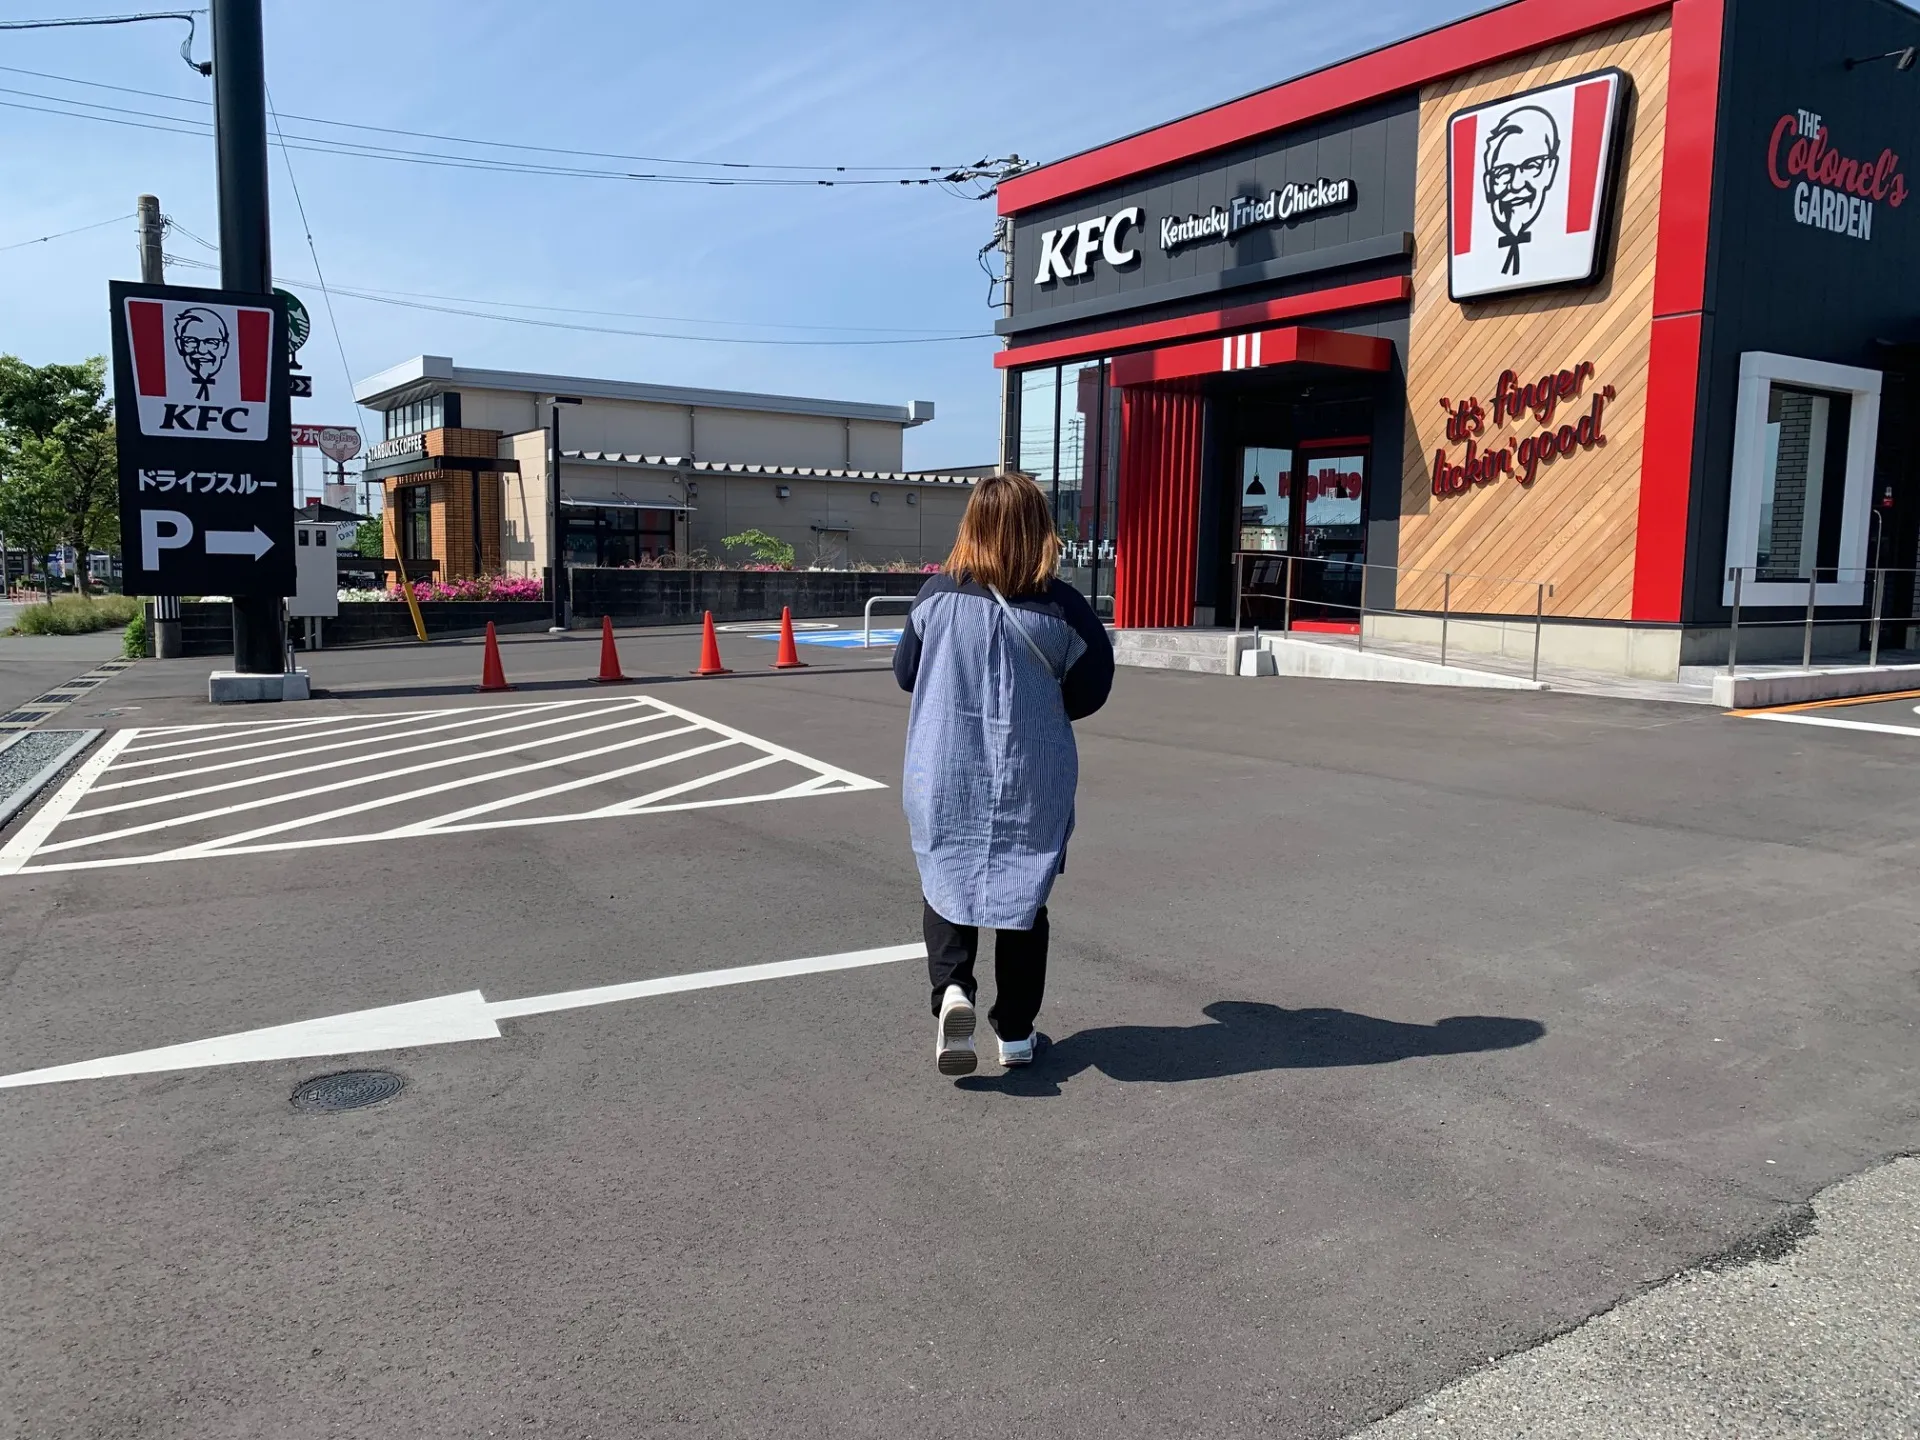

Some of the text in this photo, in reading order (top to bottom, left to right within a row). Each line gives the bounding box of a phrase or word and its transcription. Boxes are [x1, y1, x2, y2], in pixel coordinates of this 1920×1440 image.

[1797, 108, 1822, 140] THE
[1768, 114, 1909, 207] Colonel's
[1160, 178, 1349, 249] Kentucky Fried Chicken
[1794, 181, 1873, 241] GARDEN
[1034, 206, 1139, 284] KFC
[159, 404, 249, 433] KFC
[1489, 361, 1594, 424] finger
[368, 434, 422, 463] STARBUCKS COFFEE
[138, 468, 278, 495] ドライブスルー
[140, 509, 194, 571] P
[338, 529, 354, 541] Day
